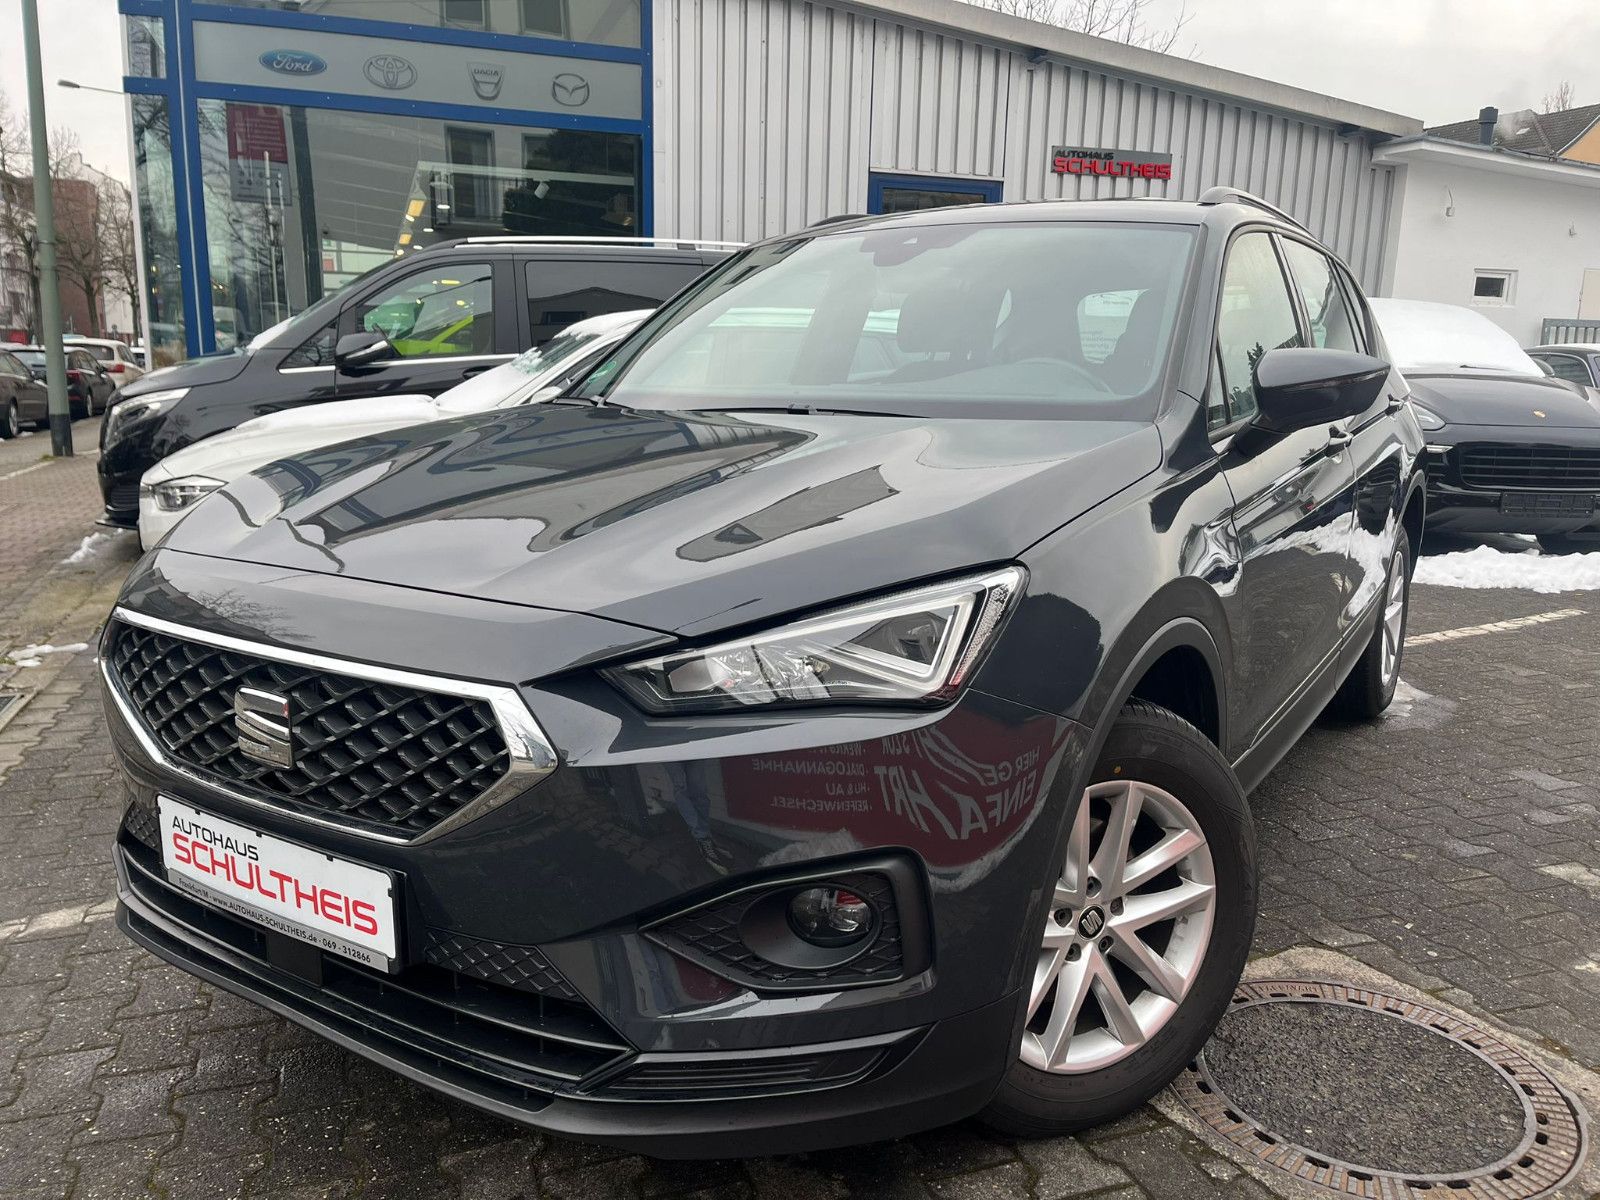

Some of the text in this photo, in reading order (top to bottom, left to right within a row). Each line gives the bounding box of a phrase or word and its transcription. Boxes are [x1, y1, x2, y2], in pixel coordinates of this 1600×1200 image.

[1053, 158, 1171, 179] SCHULTHEIS
[1054, 150, 1114, 160] AUTOHAUS
[172, 815, 259, 861] AUTOHAUS
[172, 832, 378, 936] SCHULTHEIS
[213, 896, 317, 943] www.AUTOHAUS-SCHULTHEIS.de
[323, 938, 337, 950] 069
[342, 945, 371, 963] 312866
